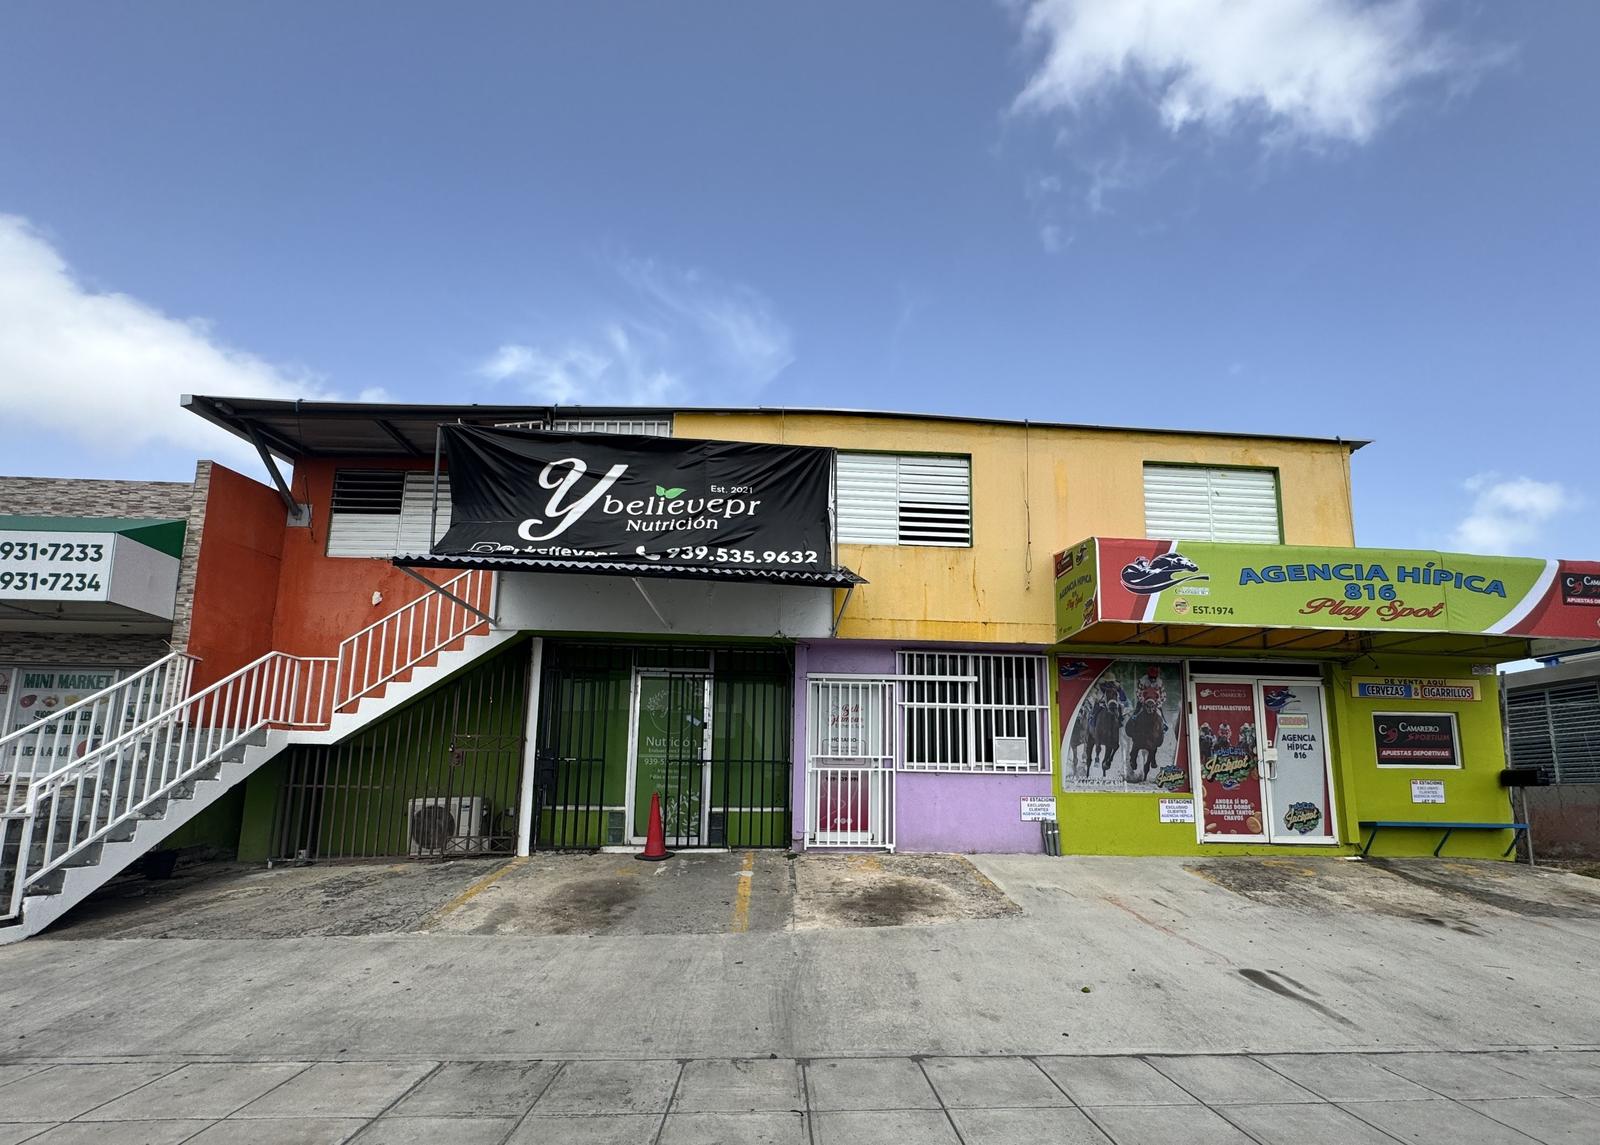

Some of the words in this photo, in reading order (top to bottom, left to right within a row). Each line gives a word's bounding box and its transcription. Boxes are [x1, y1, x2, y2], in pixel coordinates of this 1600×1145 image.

[710, 484, 729, 494] Est.
[731, 485, 754, 495] 2021
[625, 515, 718, 532] Nutrición
[666, 545, 818, 565] 939.535.9632
[1239, 564, 1389, 586] AGENCIA
[1397, 562, 1507, 598] HÍPICA
[1344, 583, 1397, 601] 816
[1192, 605, 1234, 615] EST.1974
[1299, 597, 1370, 622] Play
[1376, 600, 1445, 622] Spot
[24, 673, 54, 689] MINI
[58, 674, 114, 690] MARKET
[1366, 685, 1405, 696] CERVEZAS
[1413, 687, 1420, 697] &
[1423, 687, 1472, 698] CIGARRILLOS
[1399, 722, 1440, 733] CAMARERO
[646, 735, 697, 747] Nuticón
[1282, 734, 1316, 742] AGENCIA
[1287, 741, 1314, 751] HÍPICA
[1294, 751, 1307, 759] 816
[1205, 754, 1249, 780] Jackpot
